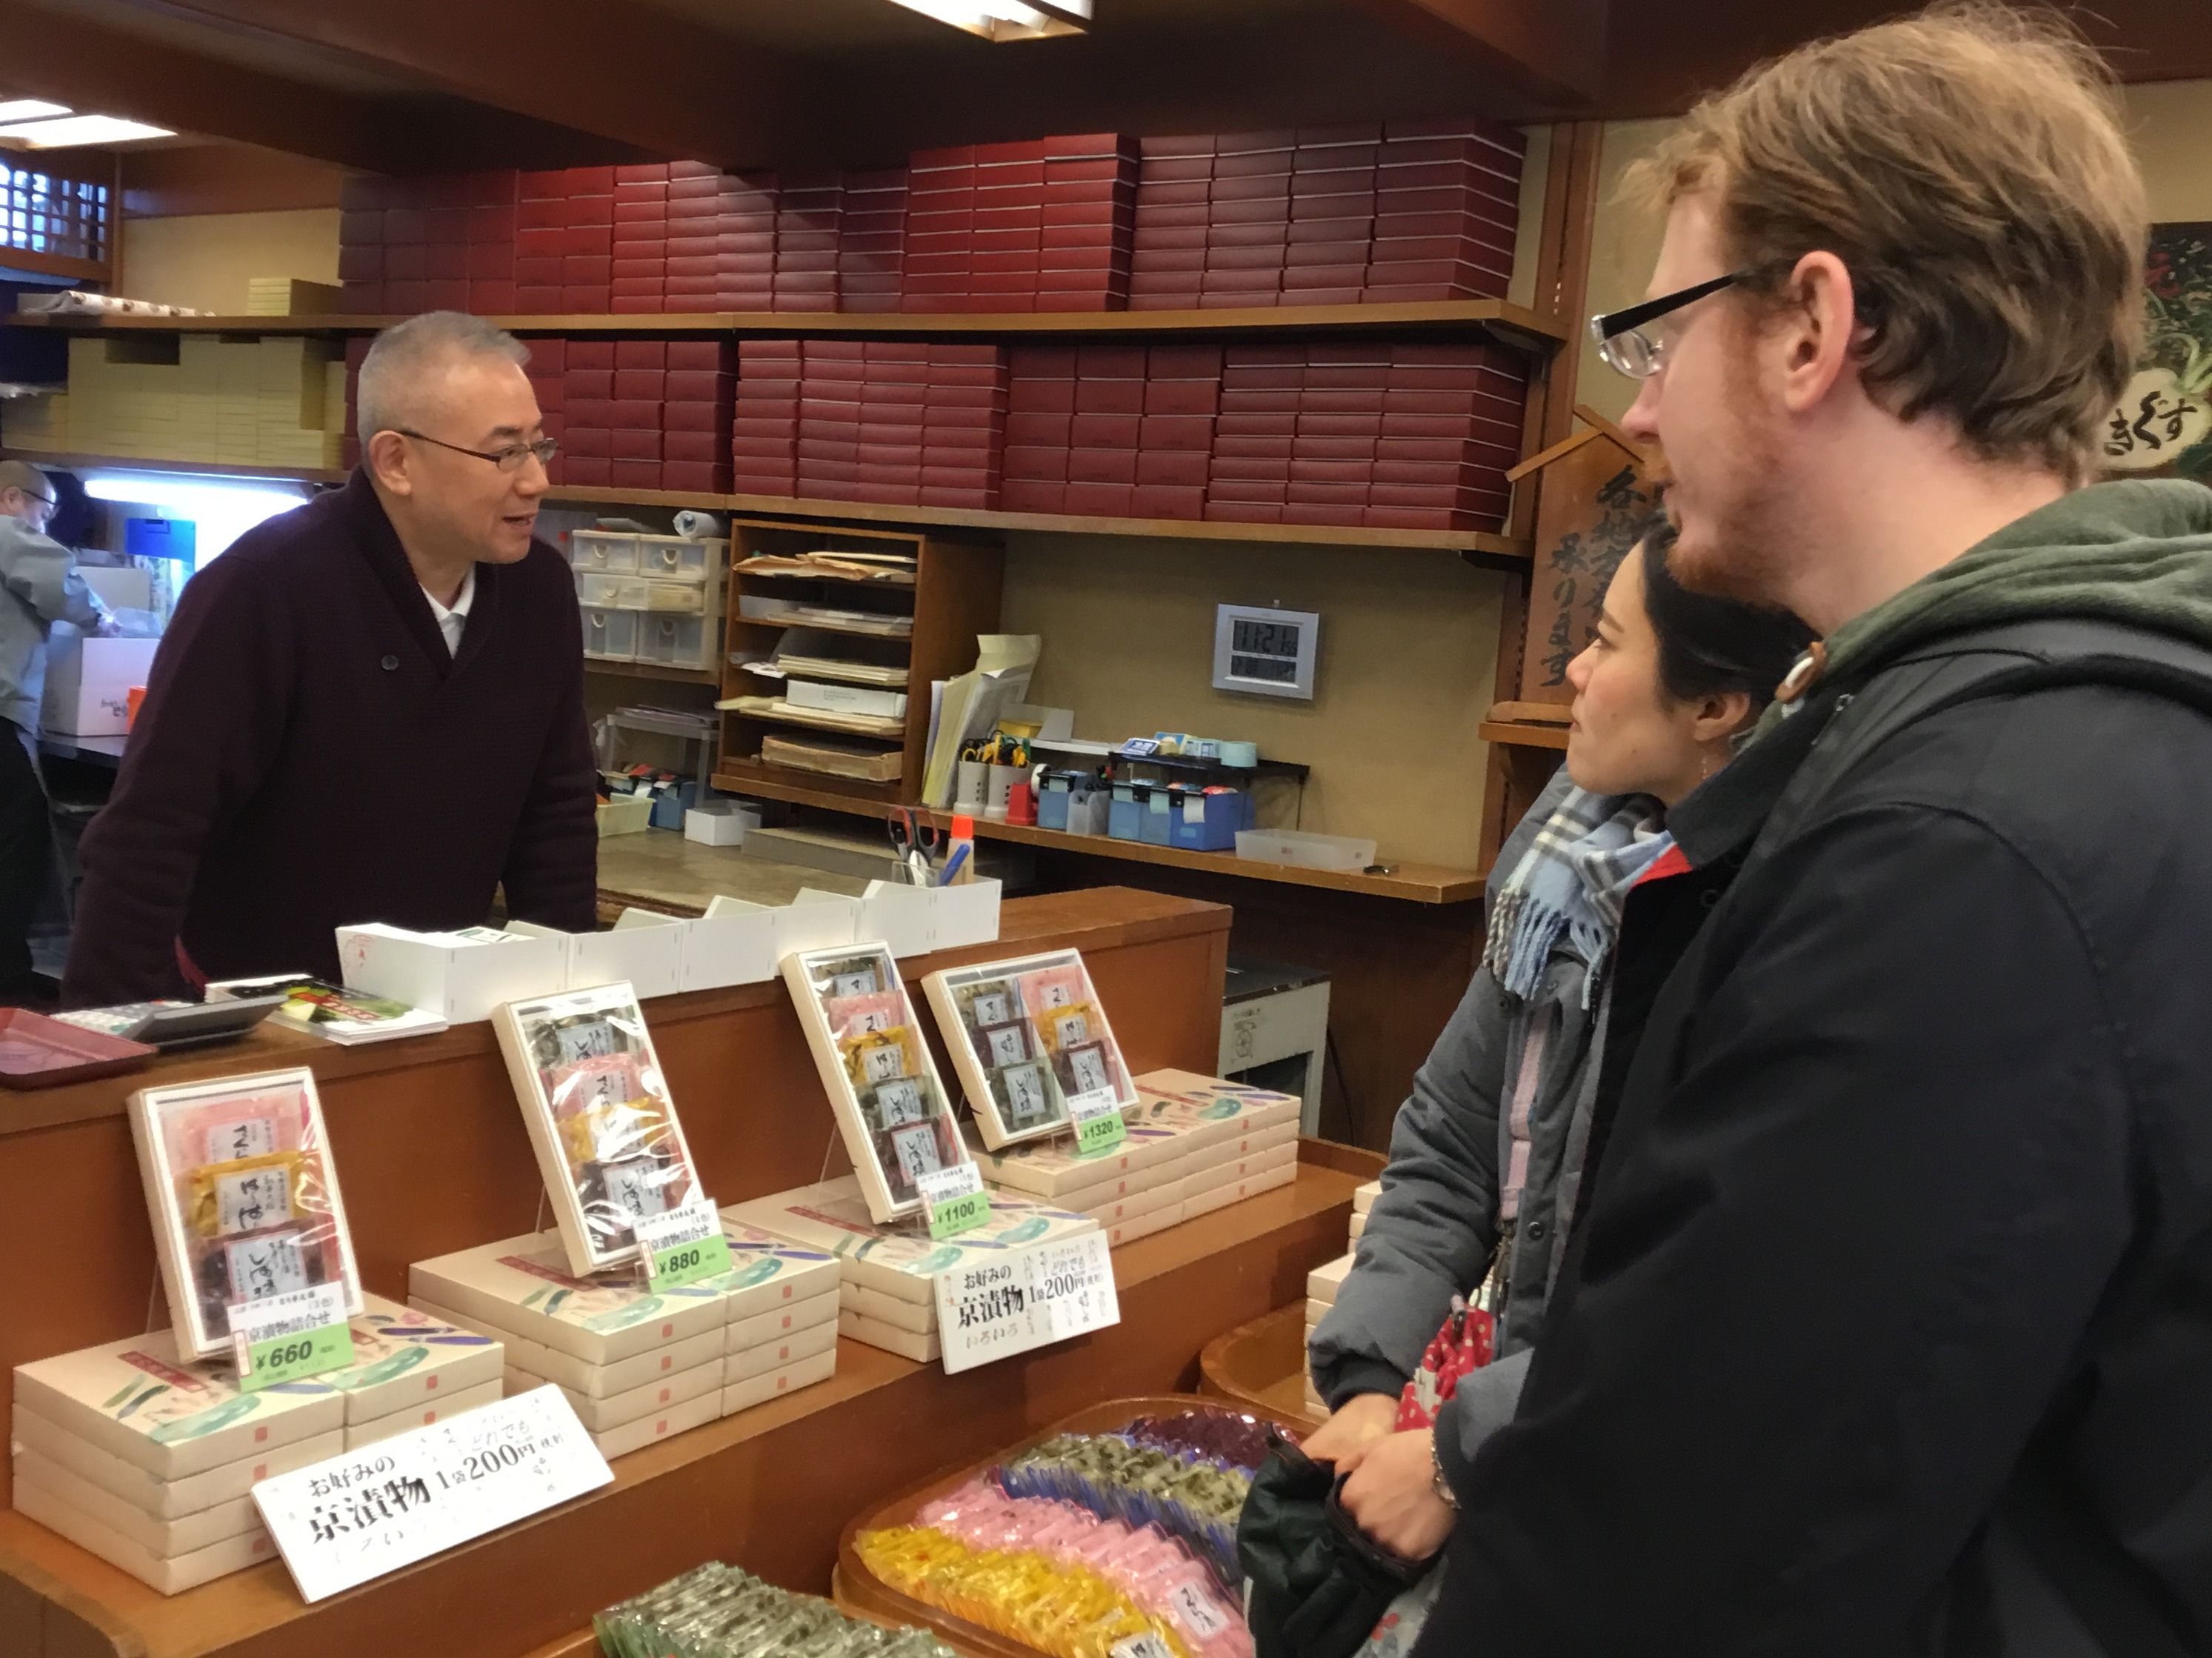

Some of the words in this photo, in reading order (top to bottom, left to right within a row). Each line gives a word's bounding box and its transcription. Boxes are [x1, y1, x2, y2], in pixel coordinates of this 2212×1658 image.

[937, 1200, 975, 1224] ¥1100
[659, 1249, 700, 1275] ¥880
[963, 1265, 1012, 1291] お好みの
[958, 1285, 1025, 1329] 京漬物
[255, 1339, 313, 1371] ¥660
[308, 1454, 396, 1498] お好みの
[308, 1476, 432, 1544] 京漬物
